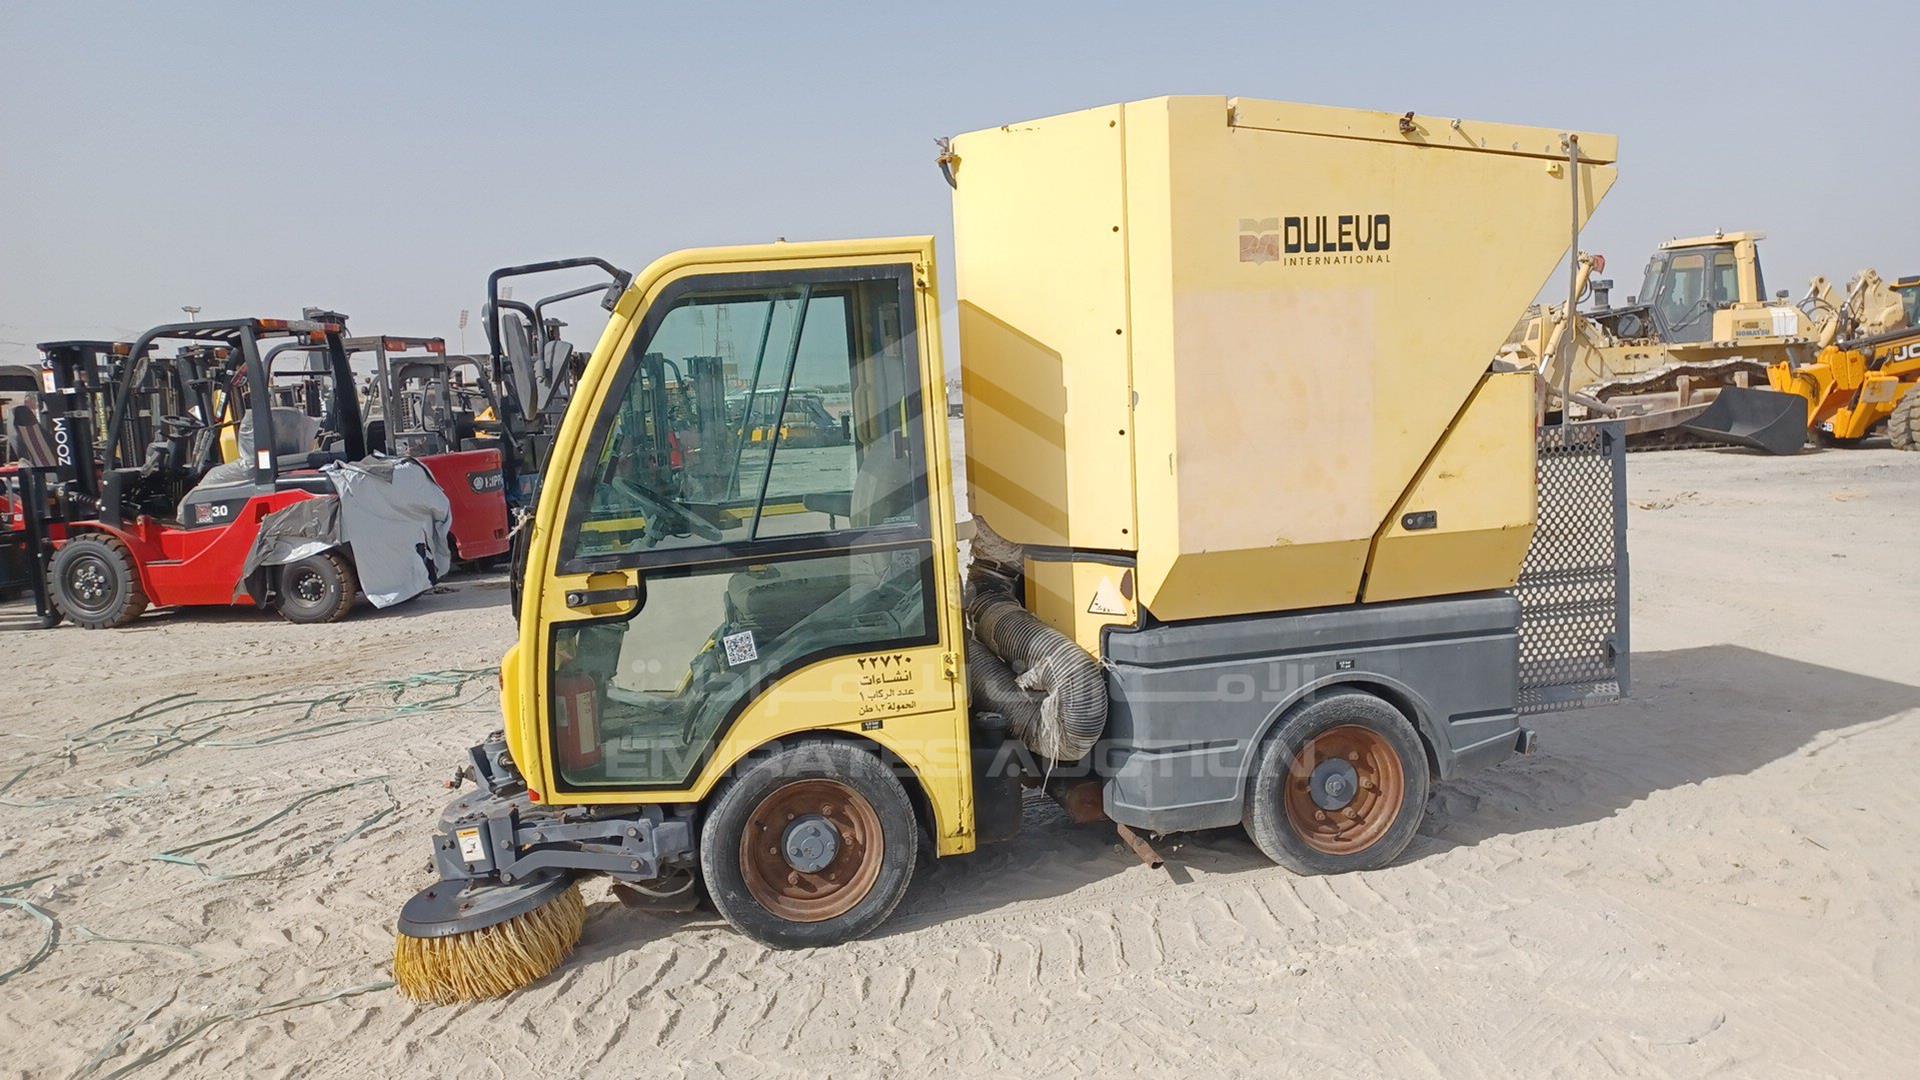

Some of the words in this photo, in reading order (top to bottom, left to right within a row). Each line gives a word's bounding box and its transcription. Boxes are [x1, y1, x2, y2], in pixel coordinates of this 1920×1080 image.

[1284, 214, 1390, 253] DULEVO
[1284, 254, 1391, 265] INTERNATIONAL
[52, 417, 71, 465] ZOOM
[212, 505, 228, 516] 30
